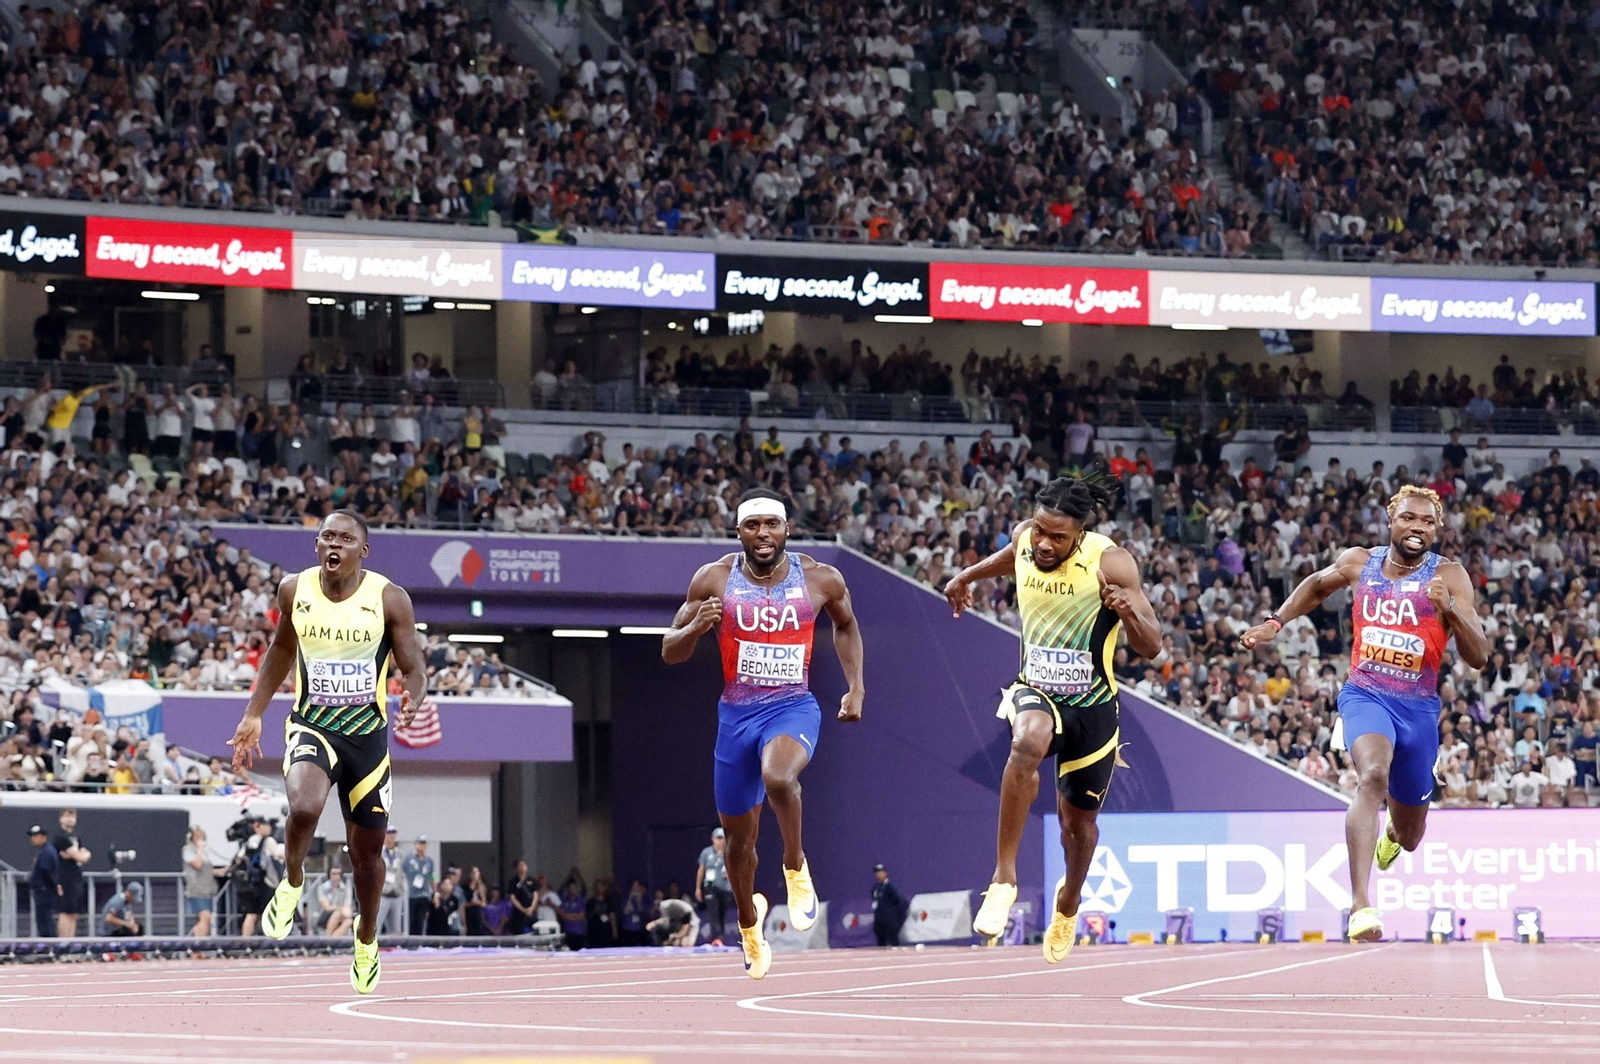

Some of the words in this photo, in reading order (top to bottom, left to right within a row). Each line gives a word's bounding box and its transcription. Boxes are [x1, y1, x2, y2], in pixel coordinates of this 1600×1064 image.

[15, 225, 80, 262] Sugoi.
[97, 236, 149, 268] Every
[152, 244, 221, 270] second,
[221, 239, 285, 276] Sugoi.
[303, 248, 357, 280] Every
[360, 255, 430, 281] second,
[430, 252, 494, 287] Sugoi.
[512, 260, 567, 292] Every
[570, 266, 641, 292] second,
[643, 262, 707, 297] Sugoi.
[724, 275, 780, 301] Every
[783, 275, 856, 301] second,
[857, 271, 923, 306] Sugoi.
[940, 279, 996, 309] Every
[999, 283, 1073, 309] second,
[1074, 279, 1141, 314] Sugoi.
[1160, 286, 1215, 316] Every
[1218, 290, 1293, 315] second,
[1295, 286, 1362, 320] Sugoi.
[1381, 293, 1438, 322] Every
[1441, 297, 1515, 321] second,
[1517, 292, 1587, 326] Sugoi.
[1024, 576, 1074, 596] JAMAICA
[736, 604, 799, 632] USA
[1363, 595, 1418, 626] USA
[301, 624, 372, 643] JAMAICA
[1377, 631, 1420, 653] TDK
[758, 645, 800, 660] TDK
[1042, 649, 1086, 665] TDK
[326, 662, 372, 676] TDK
[741, 659, 801, 677] BEDNAREK
[1029, 663, 1090, 682] THOMPSON
[312, 677, 373, 693] SEVILLE
[1128, 843, 1352, 912] TDK
[1376, 878, 1517, 911] Better
[1431, 910, 1453, 934] 4
[1517, 911, 1540, 936] 3
